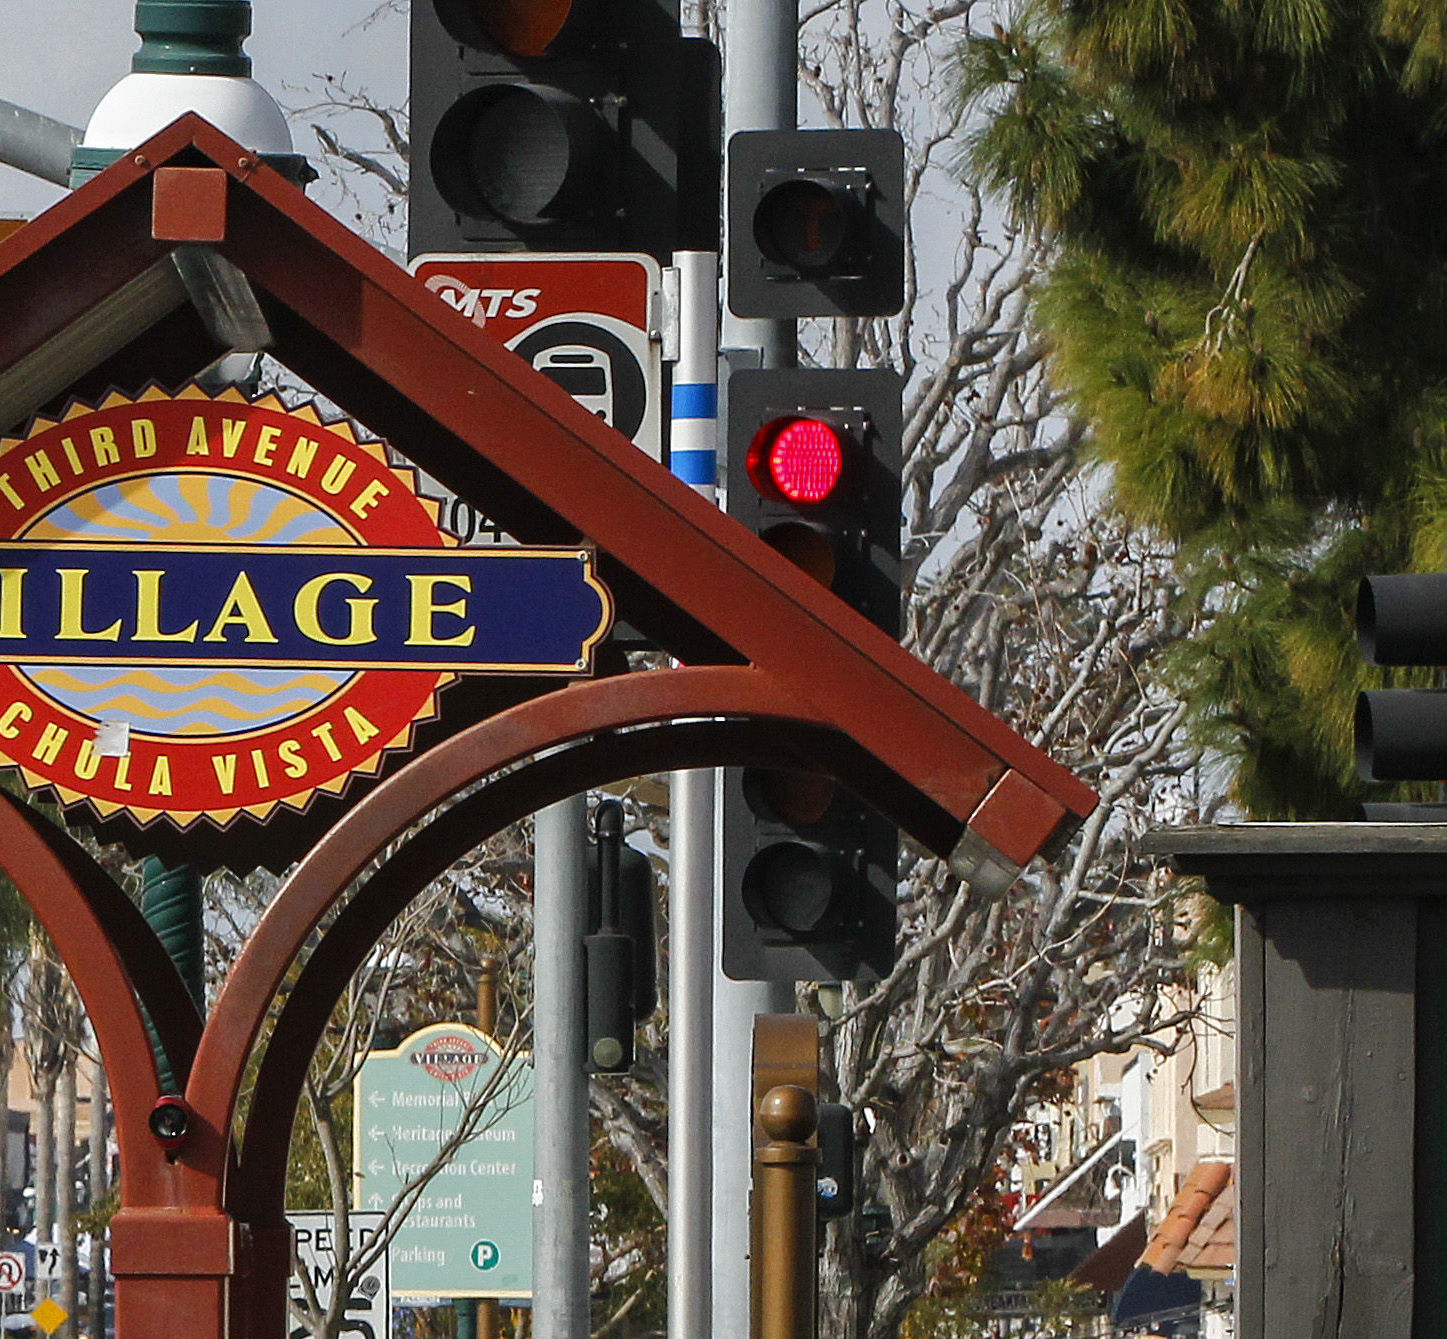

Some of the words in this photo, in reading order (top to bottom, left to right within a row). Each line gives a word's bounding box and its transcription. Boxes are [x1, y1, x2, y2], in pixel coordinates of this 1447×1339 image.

[439, 288, 542, 319] MTS
[186, 415, 391, 521] AVENUE
[447, 497, 502, 544] 04
[211, 704, 381, 796] VISTA
[392, 1090, 459, 1107] Memorial
[391, 1159, 466, 1175] Recreion
[470, 1159, 516, 1176] Center
[436, 1193, 462, 1209] and
[392, 1246, 446, 1267] Parking
[476, 1244, 493, 1267] P
